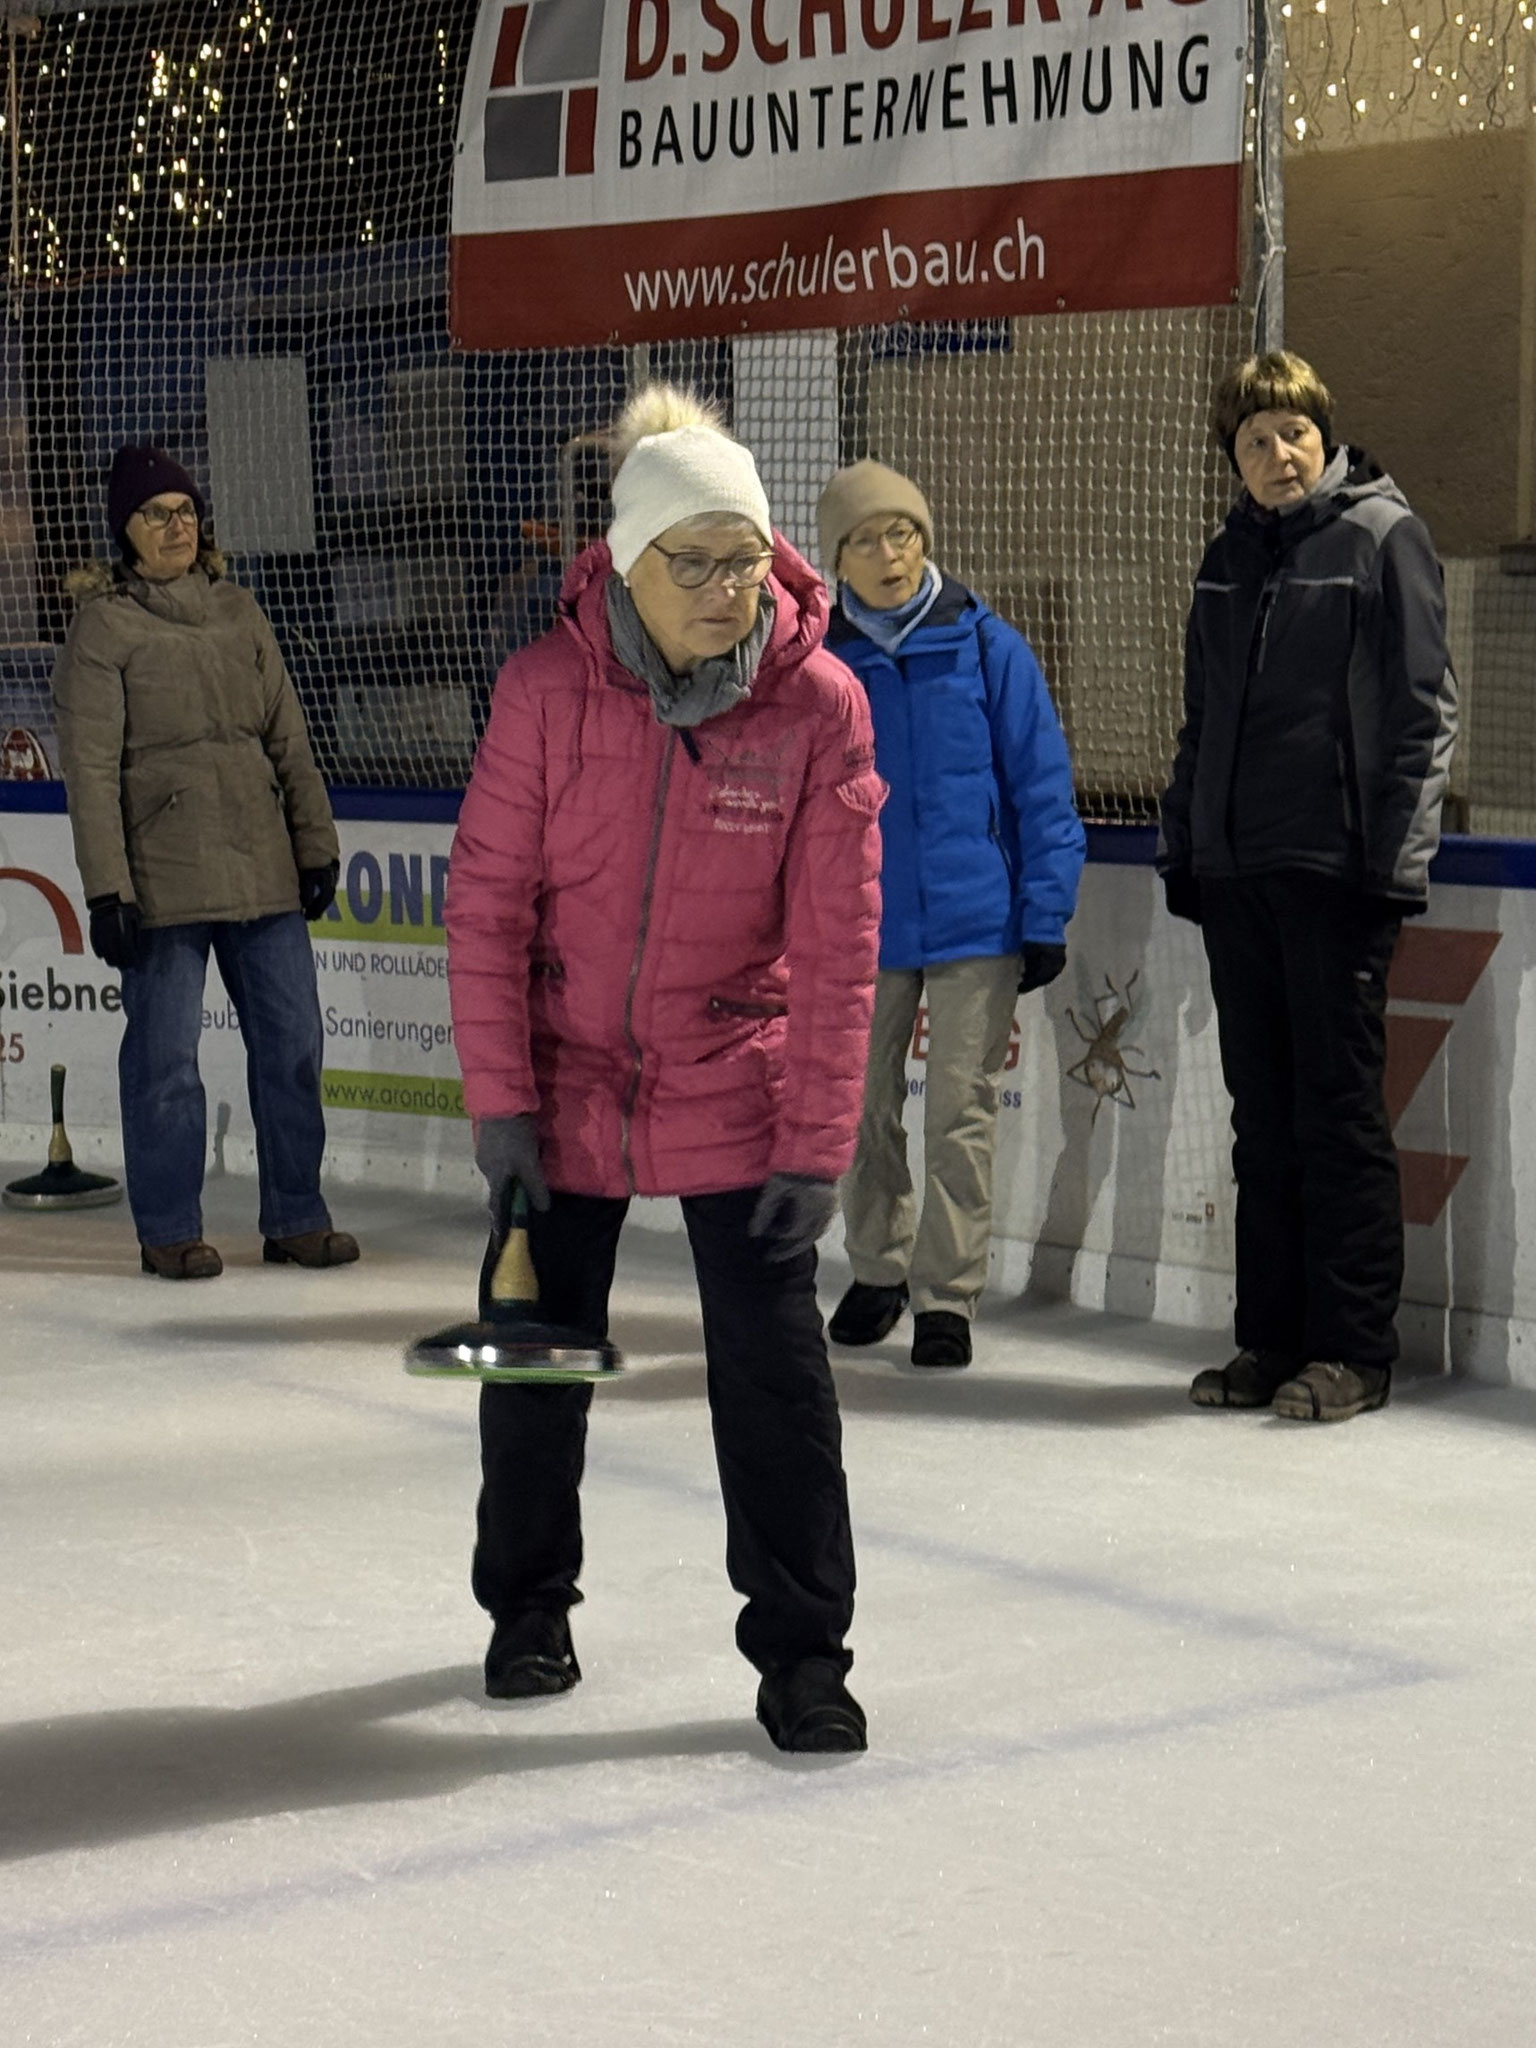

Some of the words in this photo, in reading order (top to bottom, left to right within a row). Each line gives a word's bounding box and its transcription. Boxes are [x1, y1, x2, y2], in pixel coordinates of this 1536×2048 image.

[620, 34, 1209, 169] BAUUNTERNEHMUNG
[624, 217, 1046, 312] www.schulerbau.ch
[325, 851, 450, 927] OND
[0, 966, 122, 1012] iebne
[332, 951, 366, 973] UND
[371, 951, 450, 979] ROLLLÄDE
